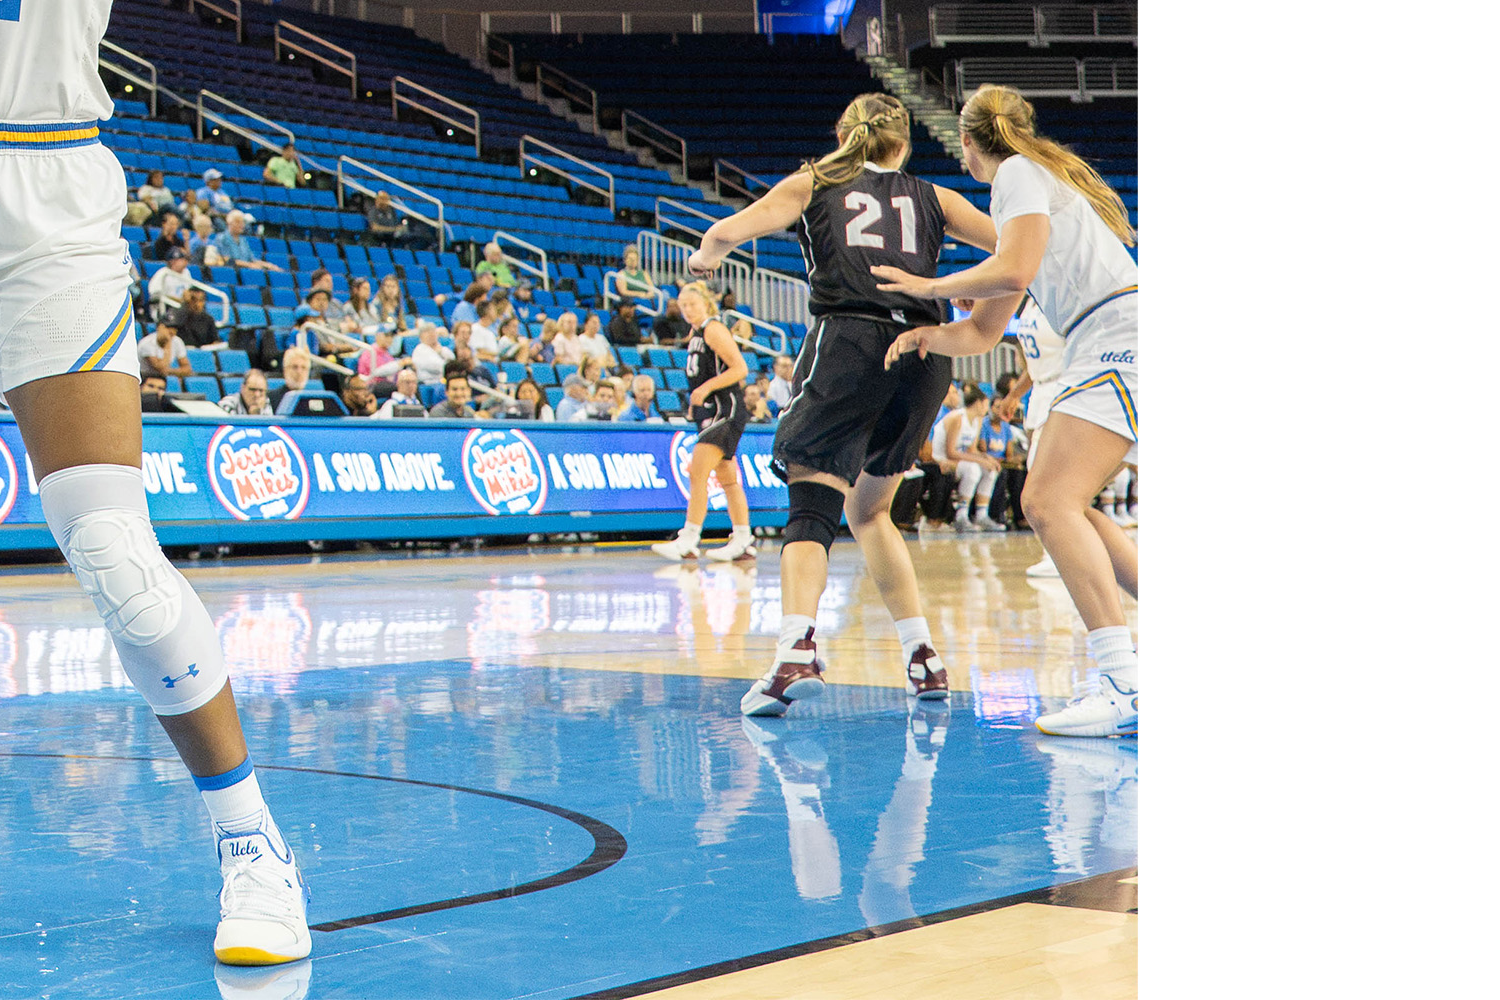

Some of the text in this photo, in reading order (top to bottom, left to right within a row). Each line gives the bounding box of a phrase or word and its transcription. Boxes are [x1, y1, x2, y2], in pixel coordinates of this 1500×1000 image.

[844, 191, 918, 254] 21
[1100, 349, 1135, 364] Ucla
[223, 443, 288, 475] Jersey
[313, 452, 455, 492] A SUB ABOVE.
[547, 453, 568, 490] A
[563, 453, 606, 490] SUB
[602, 453, 667, 490] ABOVE.
[741, 454, 760, 488] A
[230, 840, 259, 857] Ucla
